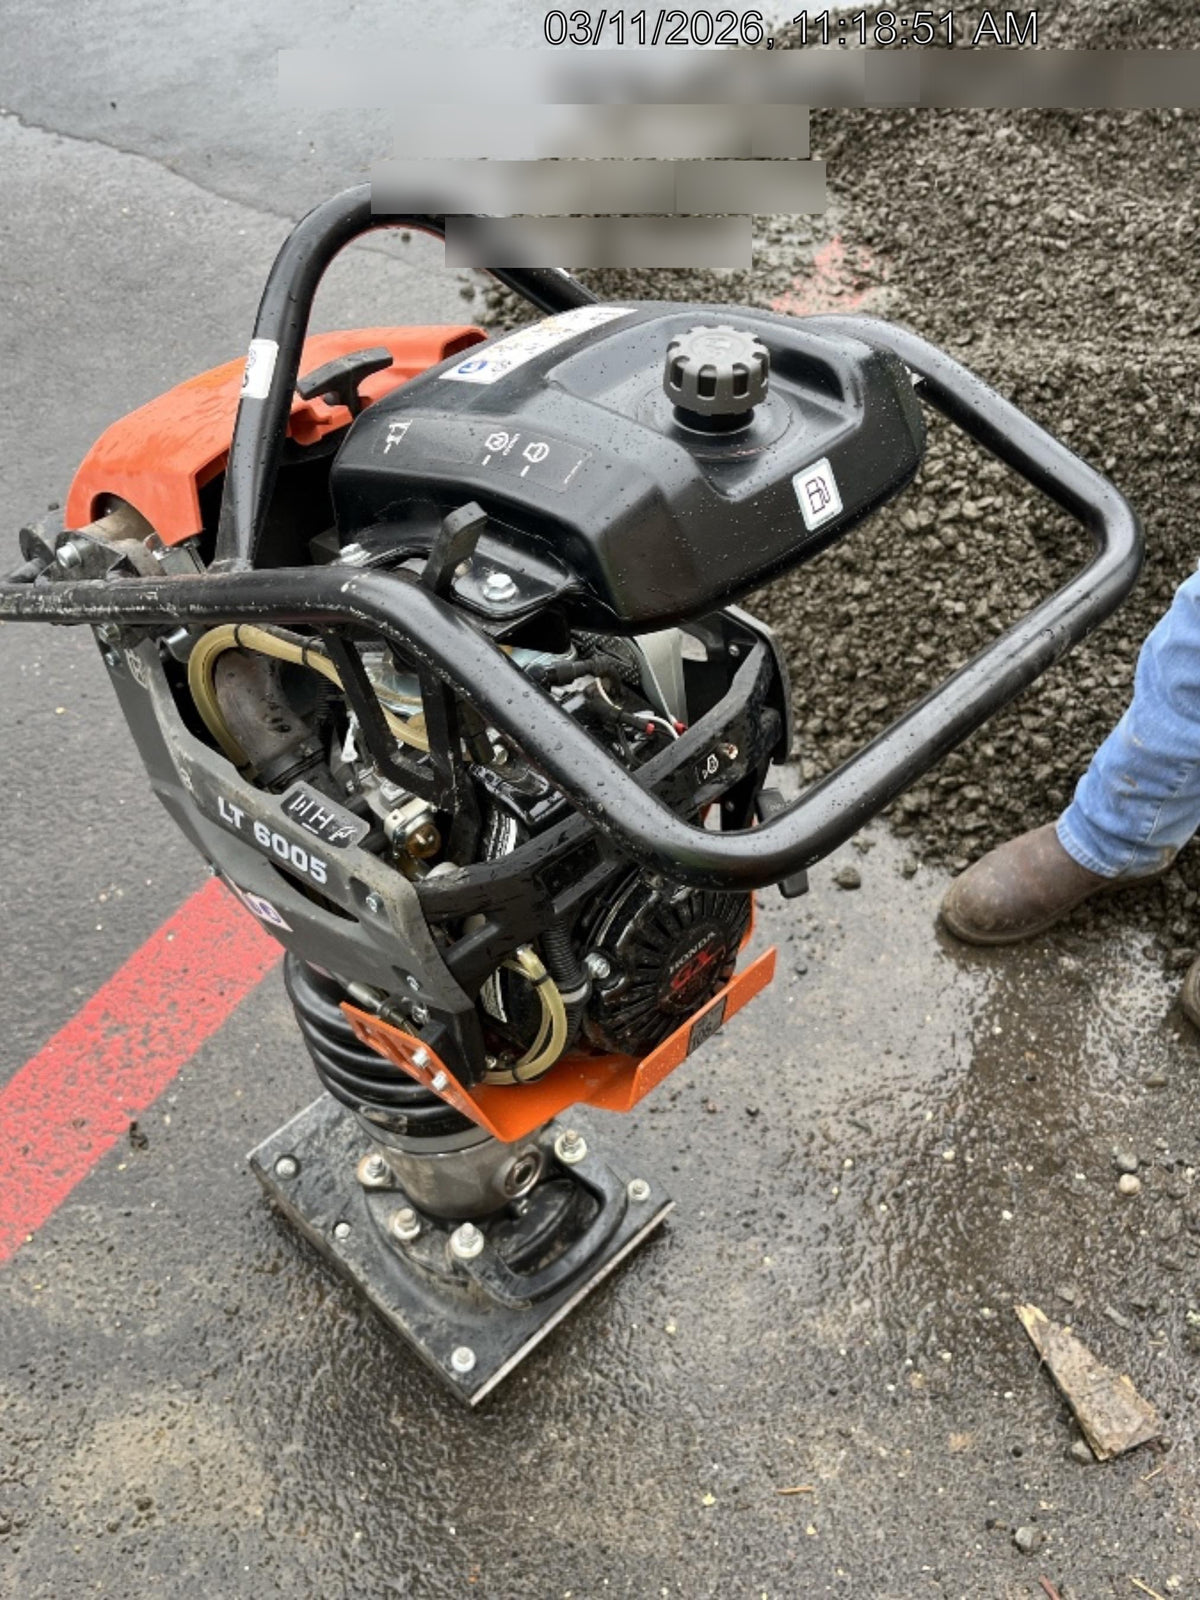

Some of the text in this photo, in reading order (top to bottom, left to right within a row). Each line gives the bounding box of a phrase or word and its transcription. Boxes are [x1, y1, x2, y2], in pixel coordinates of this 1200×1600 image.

[217, 795, 328, 885] LT 6005
[669, 931, 716, 974] HONDA
